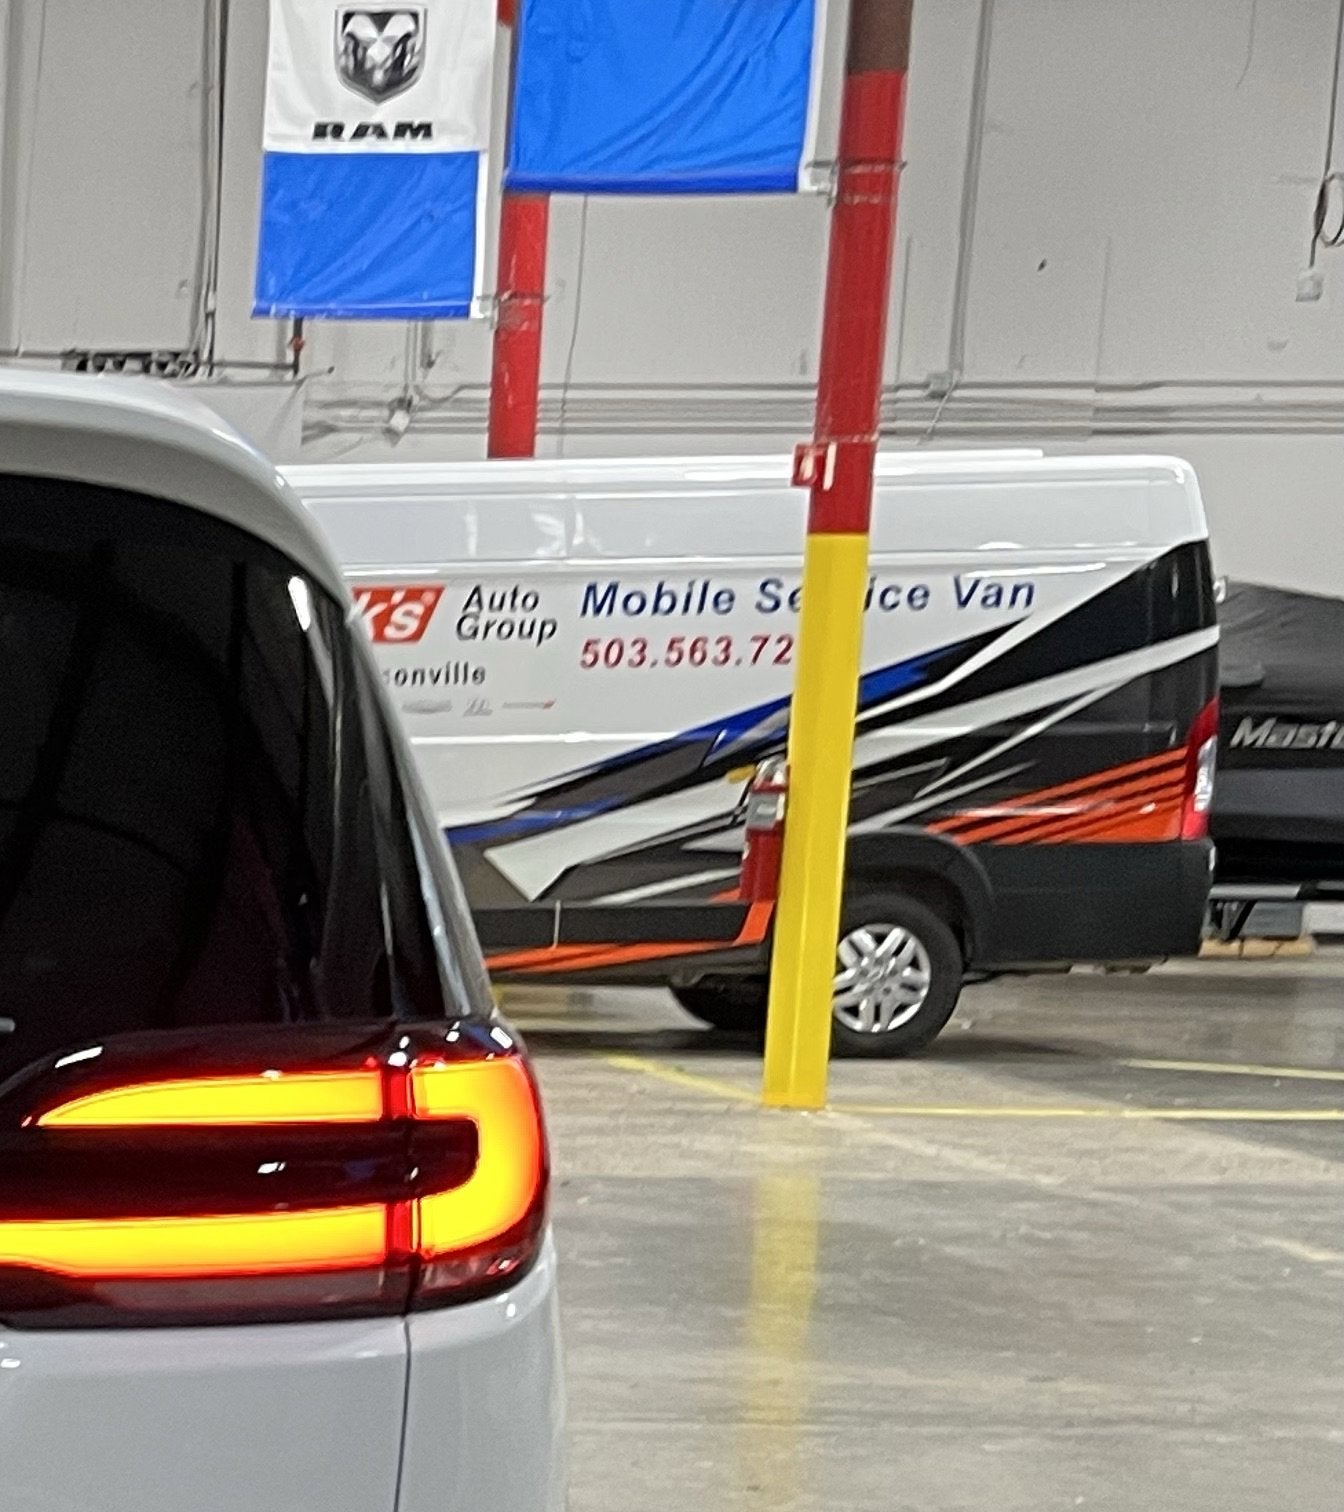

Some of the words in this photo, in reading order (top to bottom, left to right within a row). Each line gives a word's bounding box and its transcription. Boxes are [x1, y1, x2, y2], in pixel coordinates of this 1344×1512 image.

[312, 120, 433, 141] RAM
[462, 584, 540, 614] Auto
[580, 580, 736, 618] Mobile
[953, 575, 1037, 610] Van
[456, 613, 557, 647] Group
